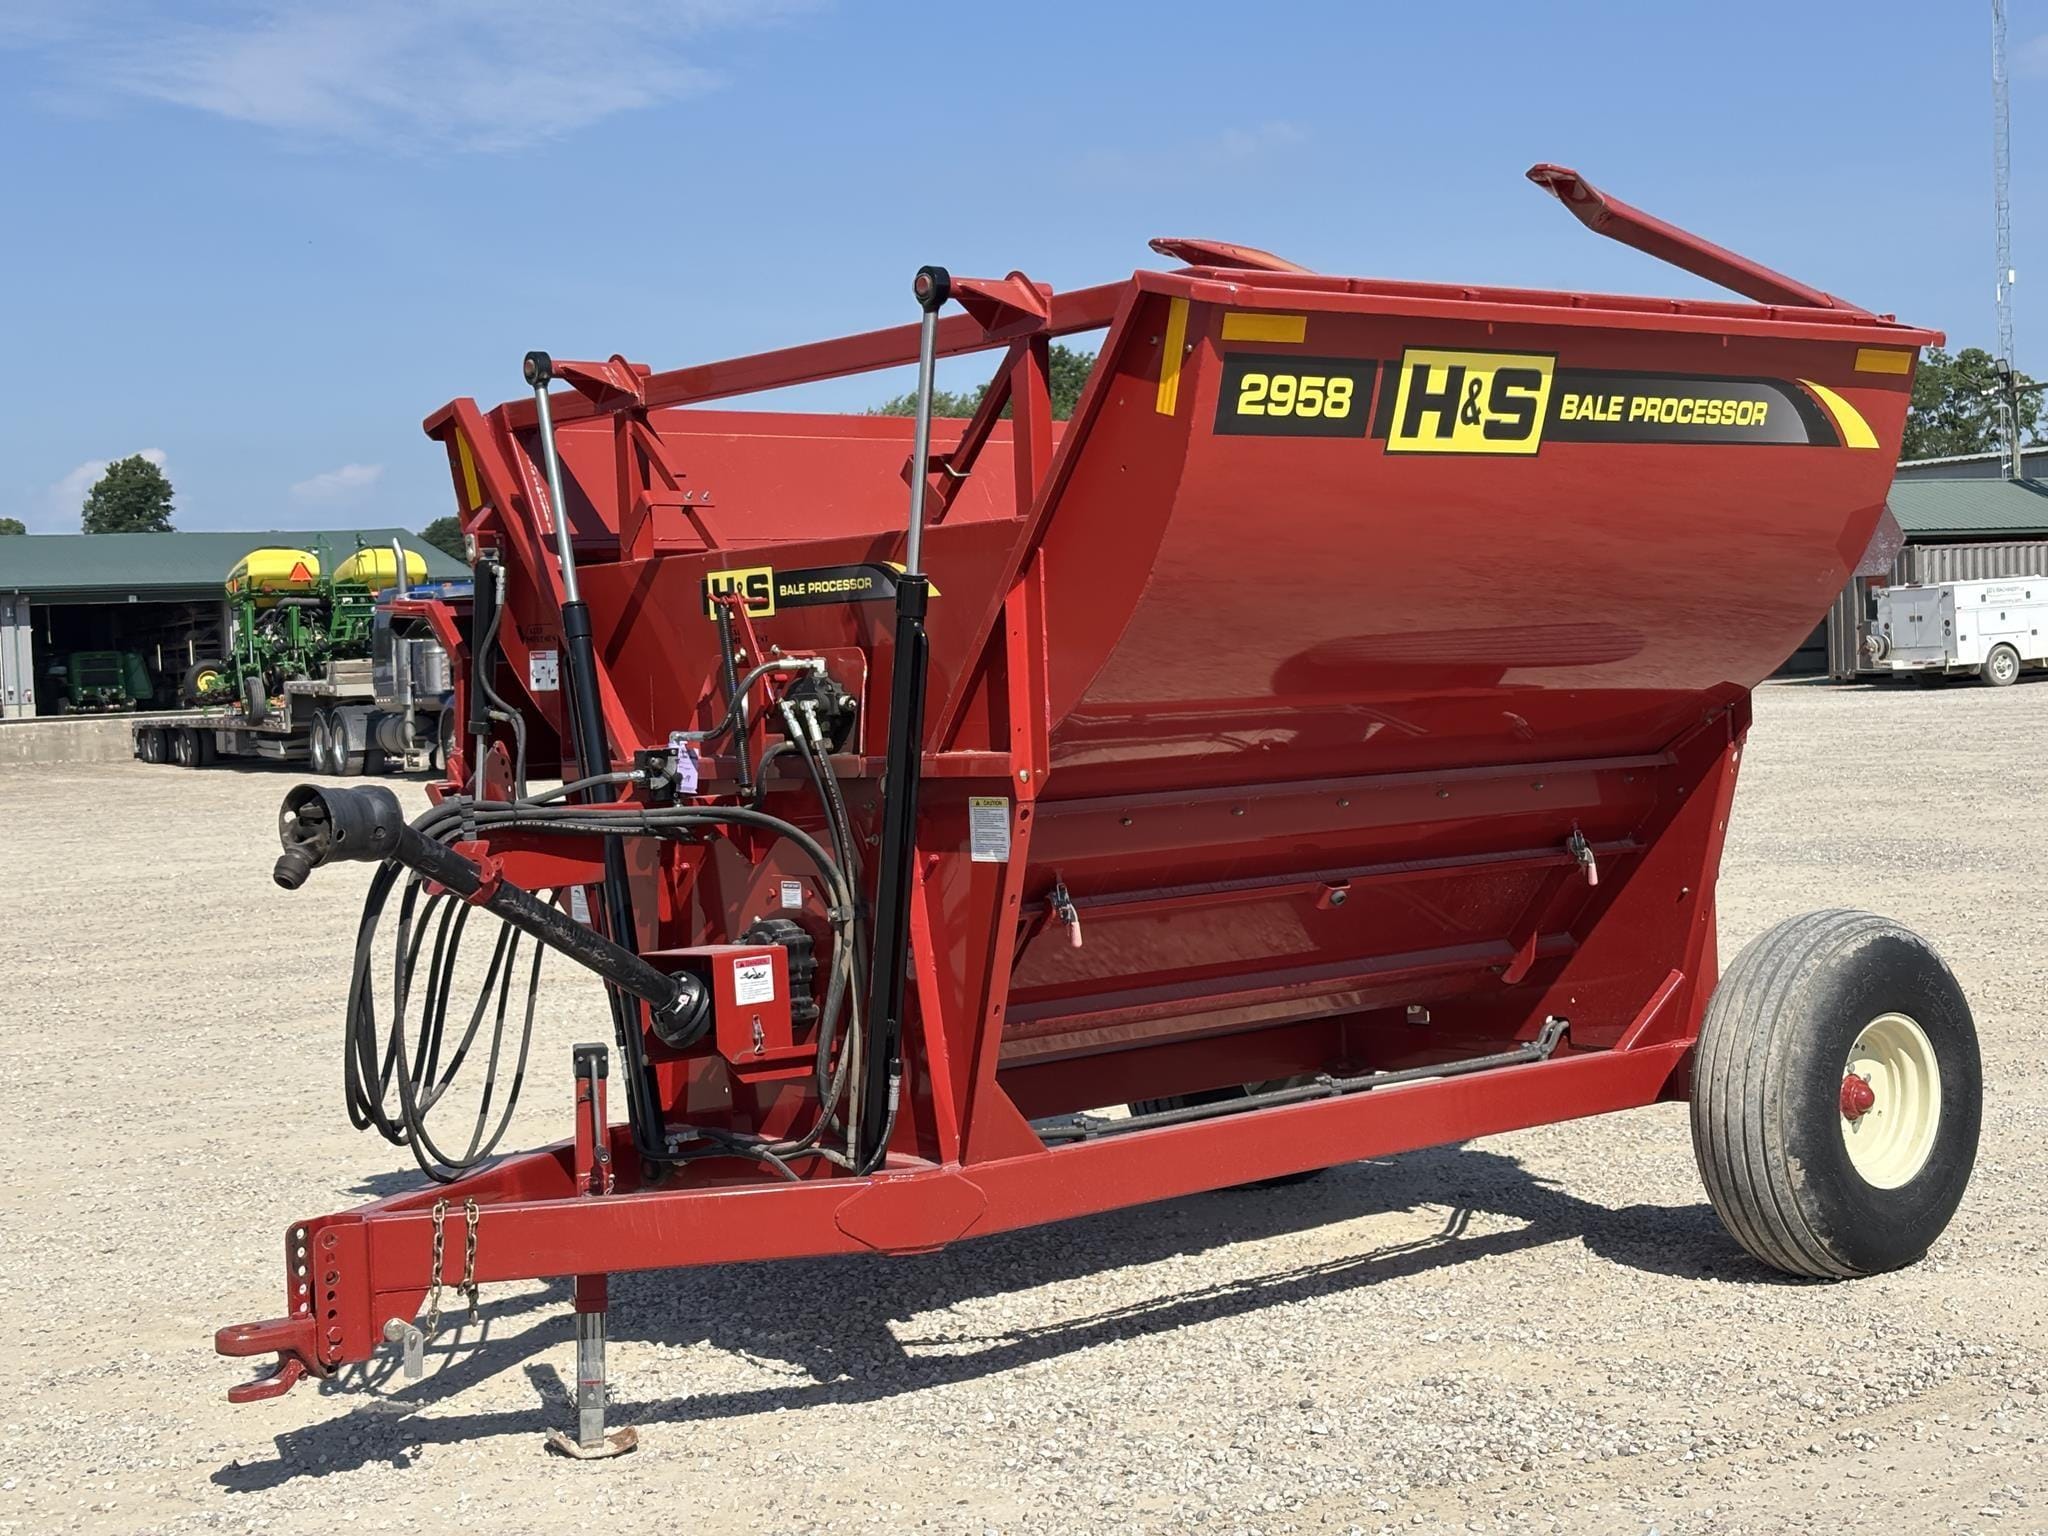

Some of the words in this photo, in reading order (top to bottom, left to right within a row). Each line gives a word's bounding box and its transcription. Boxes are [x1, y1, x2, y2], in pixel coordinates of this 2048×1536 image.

[1237, 373, 1354, 418] 2958
[1400, 363, 1543, 440] H&S
[1560, 394, 1624, 422] BALE
[1628, 397, 1768, 426] PROCESSOR
[780, 583, 806, 596] BALE
[808, 577, 873, 595] PROCESSOR
